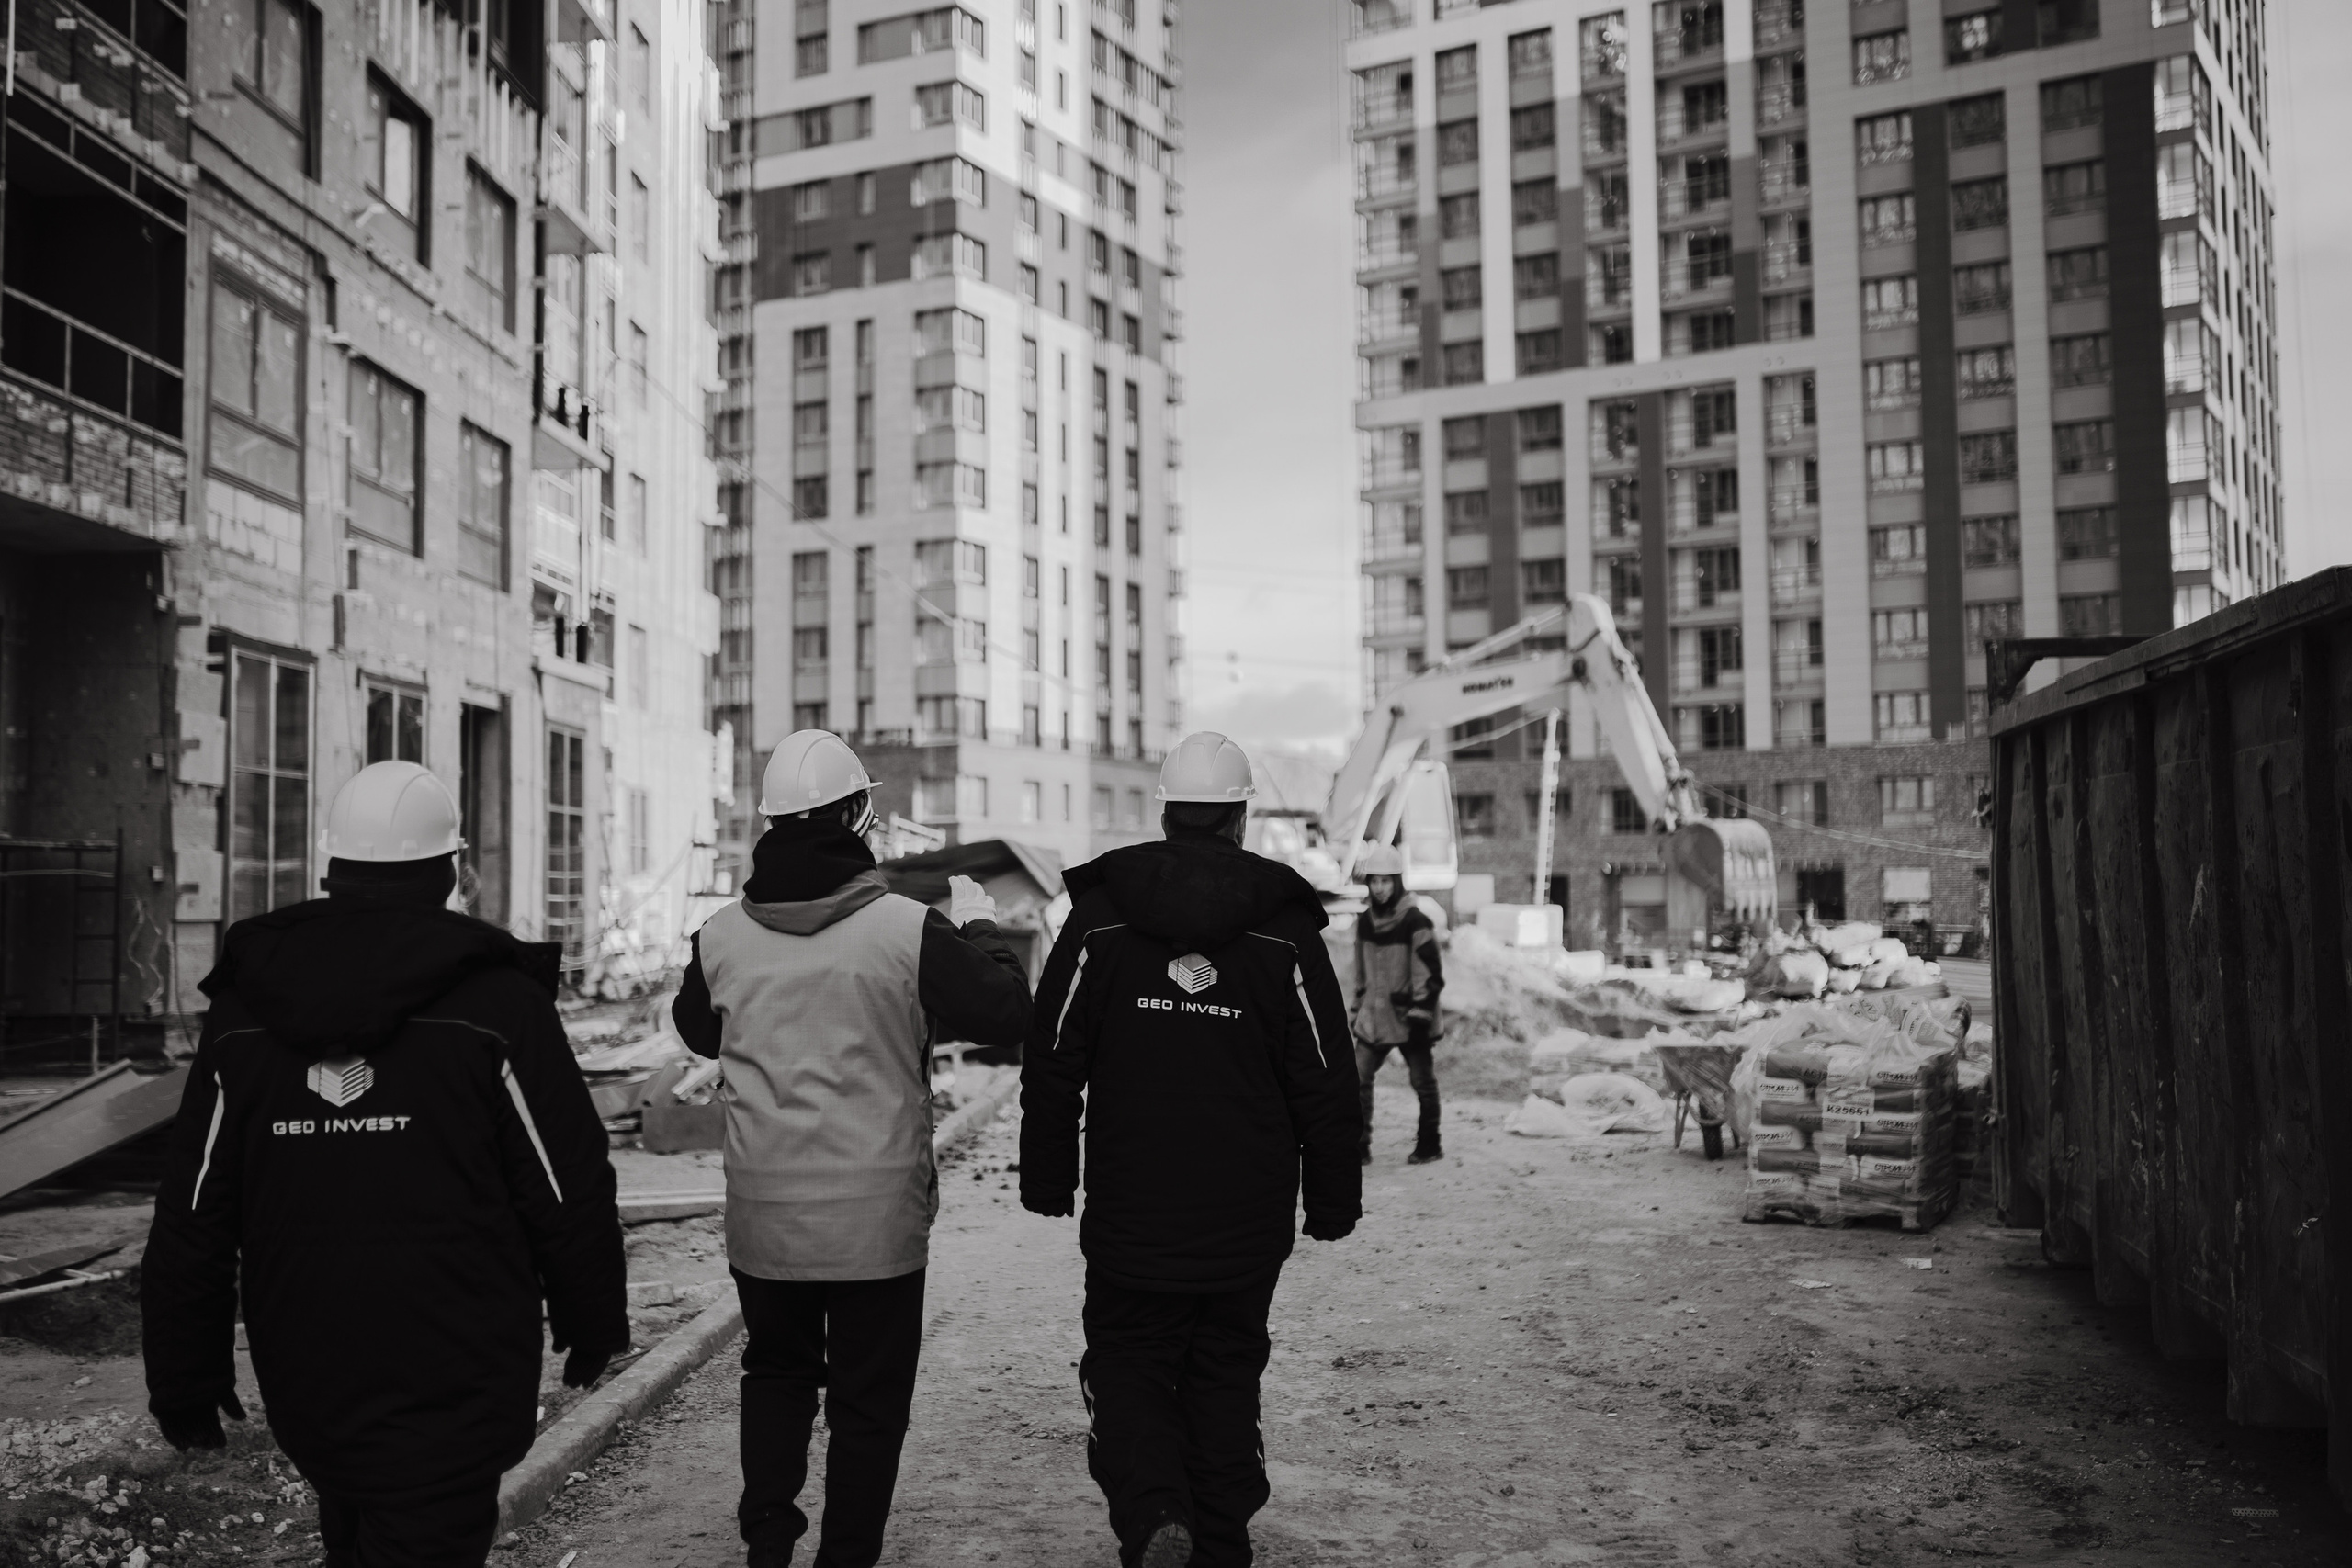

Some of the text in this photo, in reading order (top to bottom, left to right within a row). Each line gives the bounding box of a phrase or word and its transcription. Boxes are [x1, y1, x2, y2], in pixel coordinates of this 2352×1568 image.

[1137, 998, 1242, 1019] GEO INVEST
[272, 1116, 412, 1135] GEO INVEST
